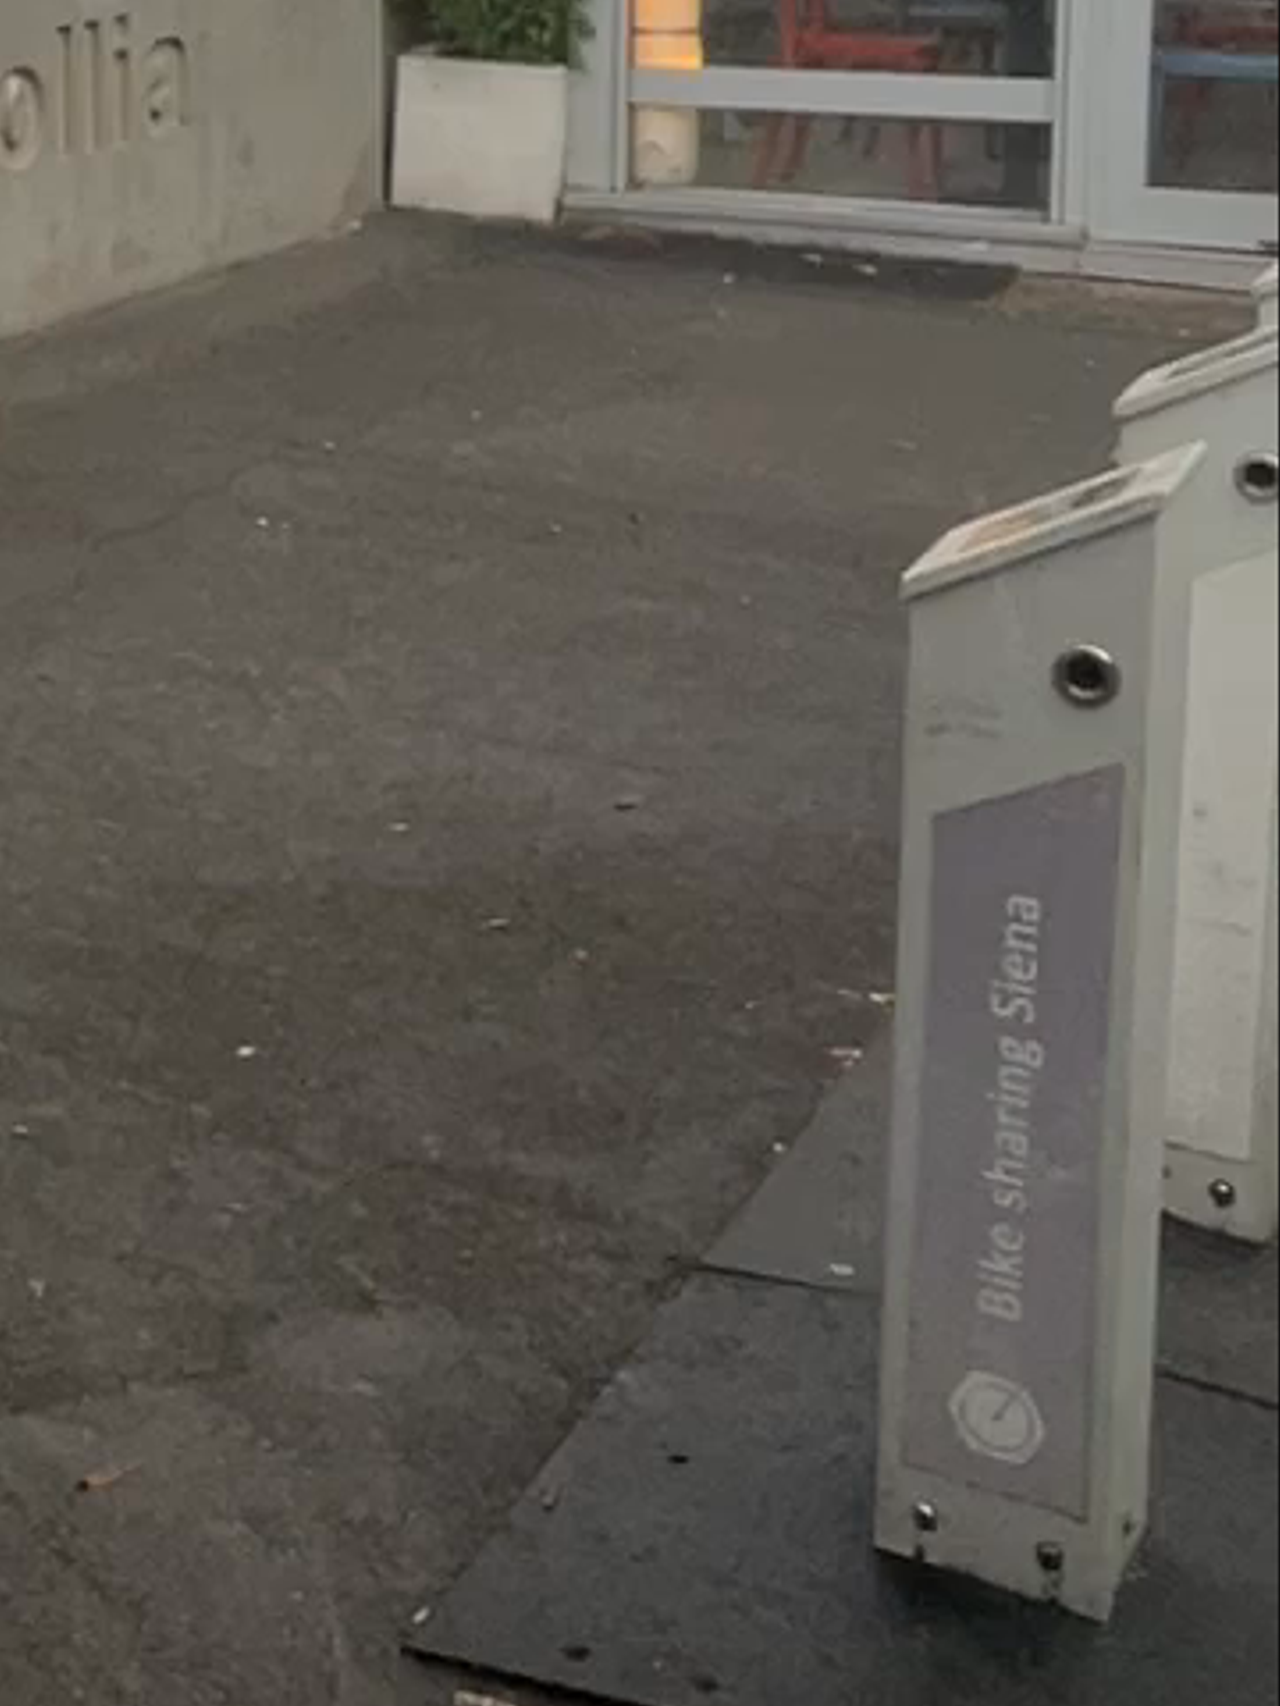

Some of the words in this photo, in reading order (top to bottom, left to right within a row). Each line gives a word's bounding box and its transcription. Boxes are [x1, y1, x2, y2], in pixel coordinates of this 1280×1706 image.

[989, 894, 1041, 1024] Siena
[982, 1035, 1044, 1213] sharing
[975, 1221, 1024, 1322] Bike
